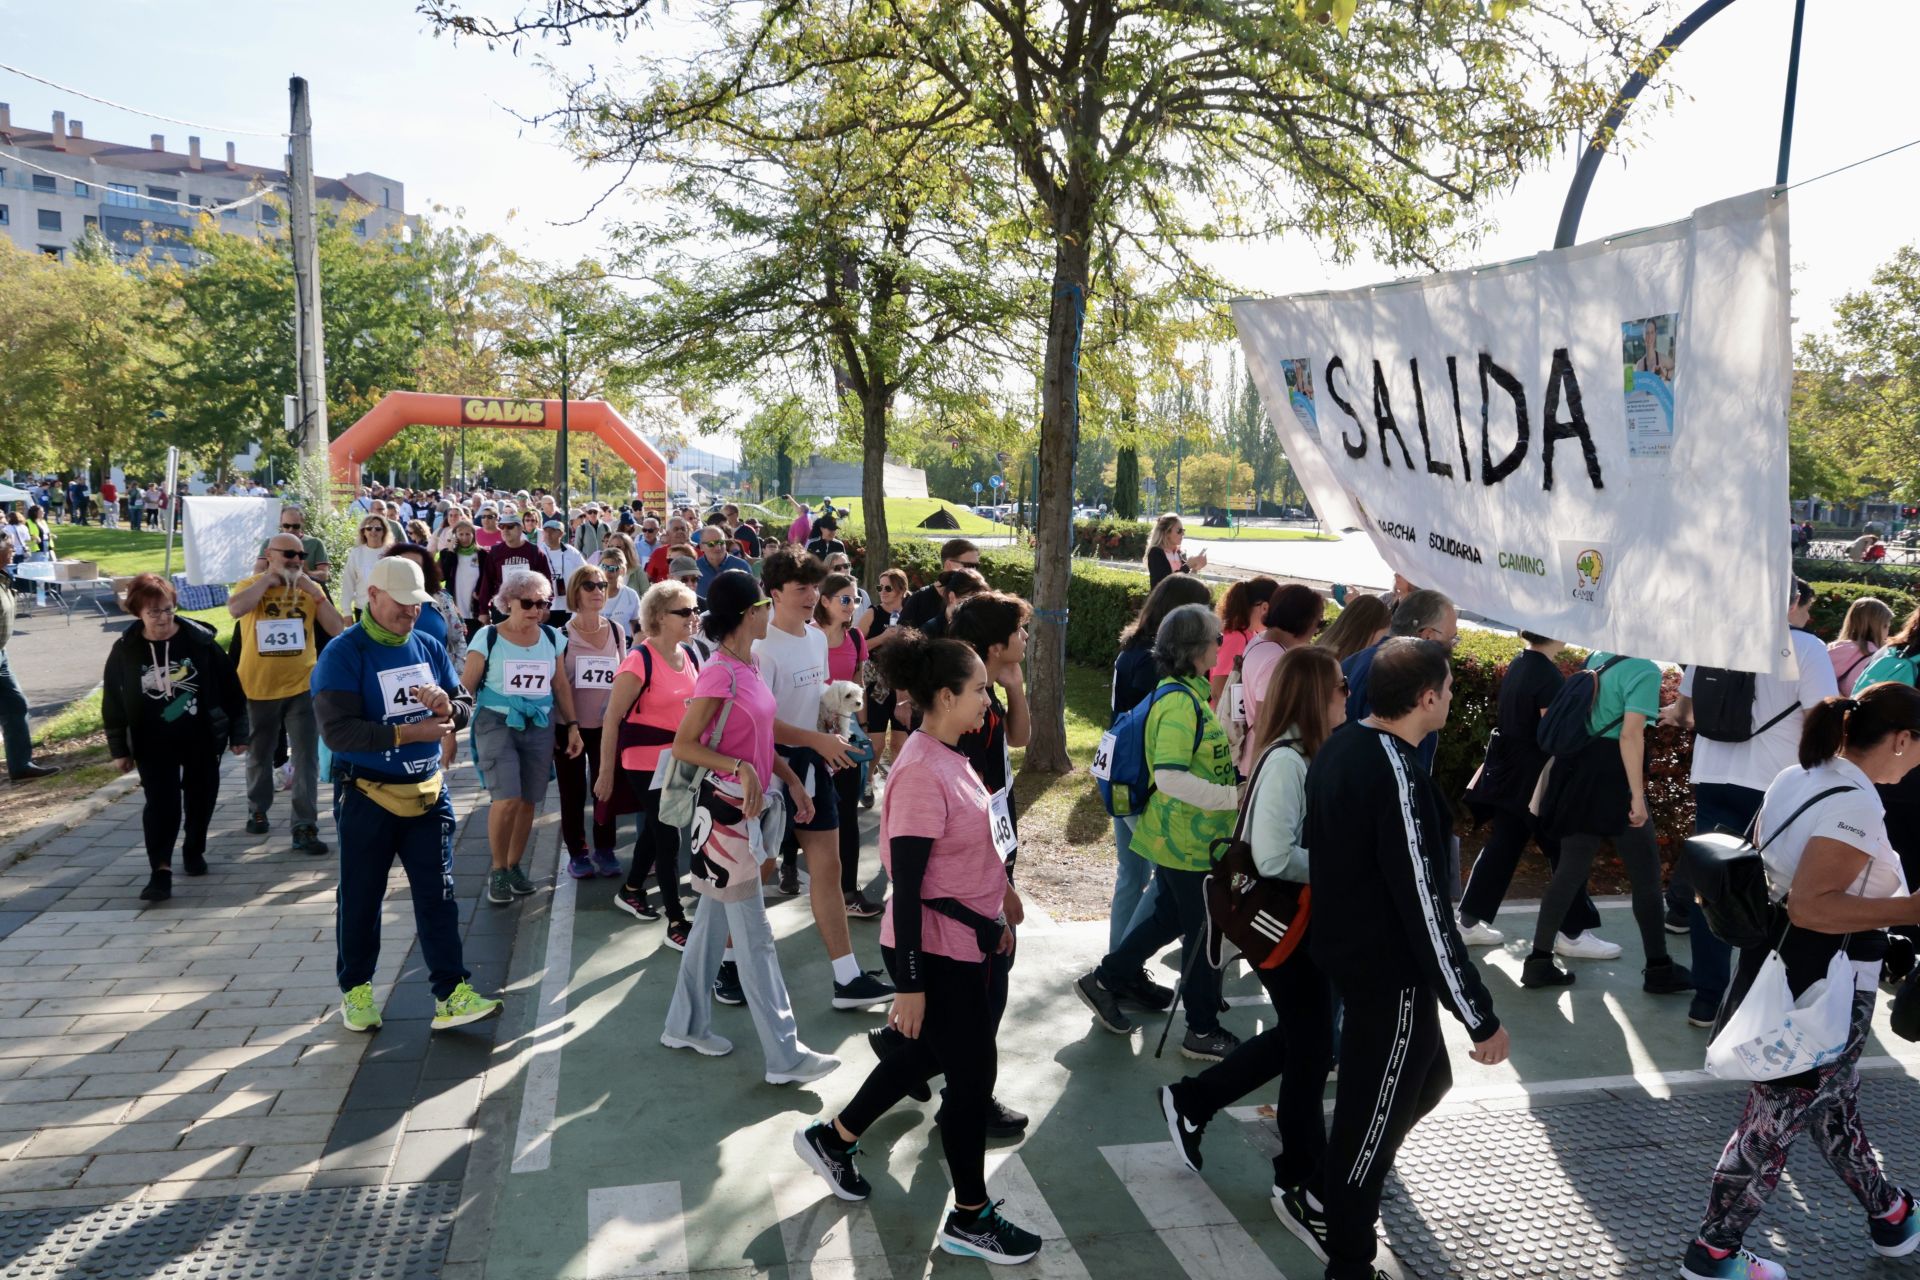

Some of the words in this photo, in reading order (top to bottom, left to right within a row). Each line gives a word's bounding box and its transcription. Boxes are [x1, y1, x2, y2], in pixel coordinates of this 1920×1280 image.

[465, 399, 545, 423] GADIS
[1326, 347, 1604, 491] SALIDA
[1429, 532, 1482, 565] SOLIDARIA
[1499, 551, 1546, 577] CAMINO
[265, 632, 298, 646] 431
[510, 675, 546, 689] 477
[582, 669, 614, 684] 478
[394, 683, 425, 706] 45
